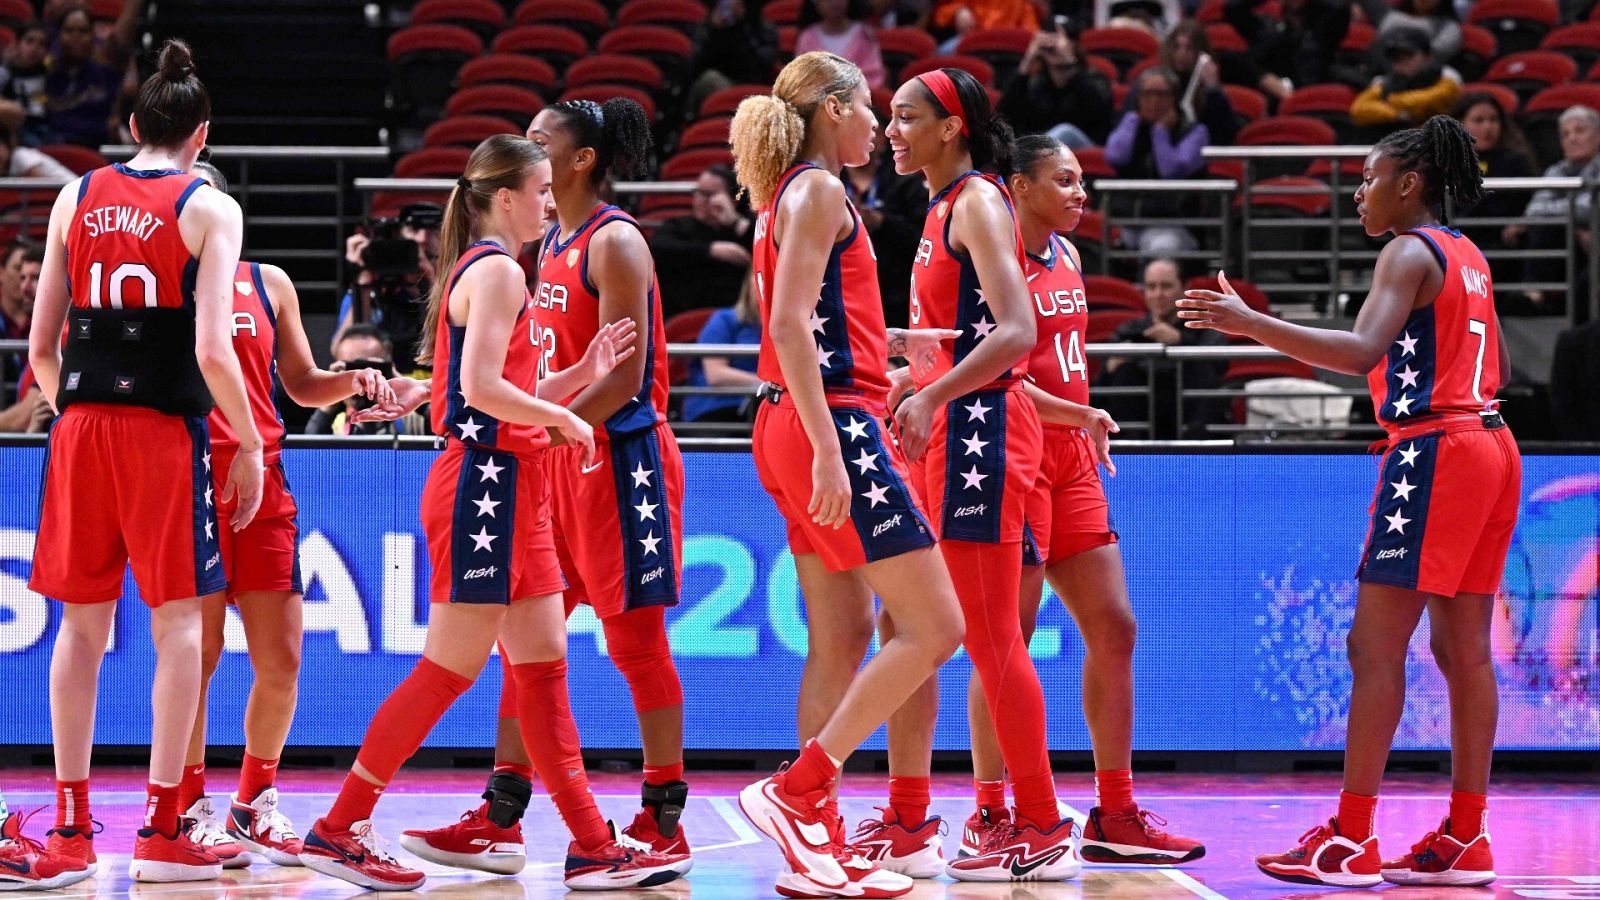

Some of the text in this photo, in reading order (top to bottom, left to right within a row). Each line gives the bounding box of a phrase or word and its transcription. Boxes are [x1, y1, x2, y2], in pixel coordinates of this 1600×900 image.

[83, 205, 164, 242] STEWART
[1034, 288, 1089, 317] USA
[1054, 330, 1087, 383] 14
[1468, 318, 1486, 403] 7
[954, 503, 988, 518] USA
[872, 513, 903, 538] USA
[1376, 547, 1409, 560] USA
[463, 565, 498, 580] USA
[641, 566, 665, 585] USA
